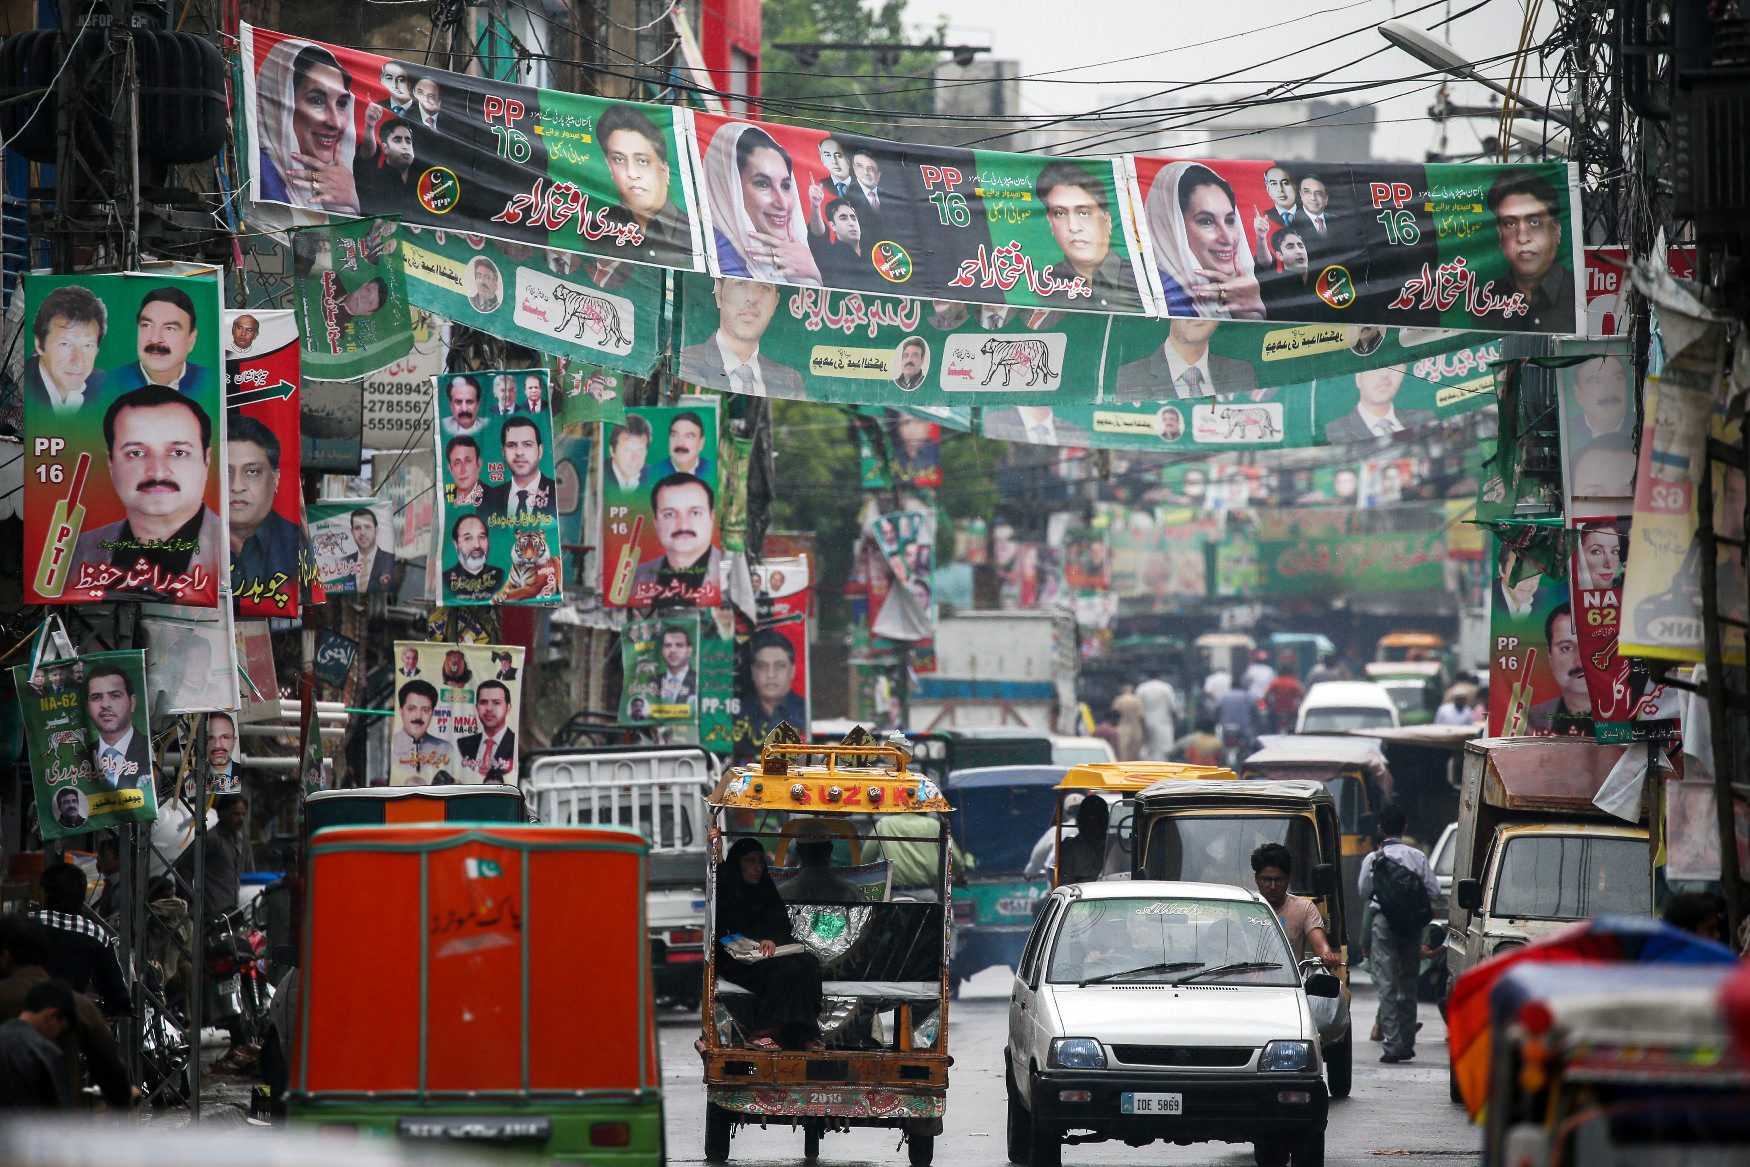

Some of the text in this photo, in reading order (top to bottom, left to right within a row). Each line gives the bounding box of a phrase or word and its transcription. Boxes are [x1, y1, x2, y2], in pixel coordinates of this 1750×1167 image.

[484, 95, 524, 127] PP
[491, 126, 531, 163] 16
[920, 164, 963, 192] PP
[431, 198, 451, 209] PPP
[1370, 182, 1412, 209] PP
[491, 177, 644, 247] چوہدری افتخار احمد
[929, 191, 971, 227] 16
[1377, 210, 1420, 246] 16
[888, 266, 906, 278] PPP
[948, 240, 1092, 299] چوہدری افتخار احمد
[1388, 255, 1529, 318] چوہدری افتخار احمد
[1585, 267, 1617, 291] The
[234, 369, 253, 385] نشان
[34, 437, 66, 457] PP
[35, 464, 64, 483] 16
[488, 462, 505, 471] NA
[489, 473, 504, 481] 62
[445, 484, 455, 493] PP
[446, 494, 454, 503] 16
[609, 506, 629, 518] PP
[610, 523, 628, 535] 16
[179, 538, 200, 555] پاکستان
[44, 525, 71, 587] PTI
[74, 558, 208, 597] راجہ راشد حفیظ
[616, 559, 632, 598] PTI
[231, 569, 289, 608] چوہدر
[1583, 591, 1620, 608] NA
[1586, 608, 1617, 625] 62
[1497, 637, 1518, 651] PP
[1499, 657, 1518, 670] 16
[40, 692, 78, 711] NA-62
[701, 698, 741, 715] PP-16
[434, 709, 452, 718] MPA
[454, 717, 478, 726] MNA
[453, 726, 479, 734] NA-62
[1158, 1100, 1179, 1111] 5869
